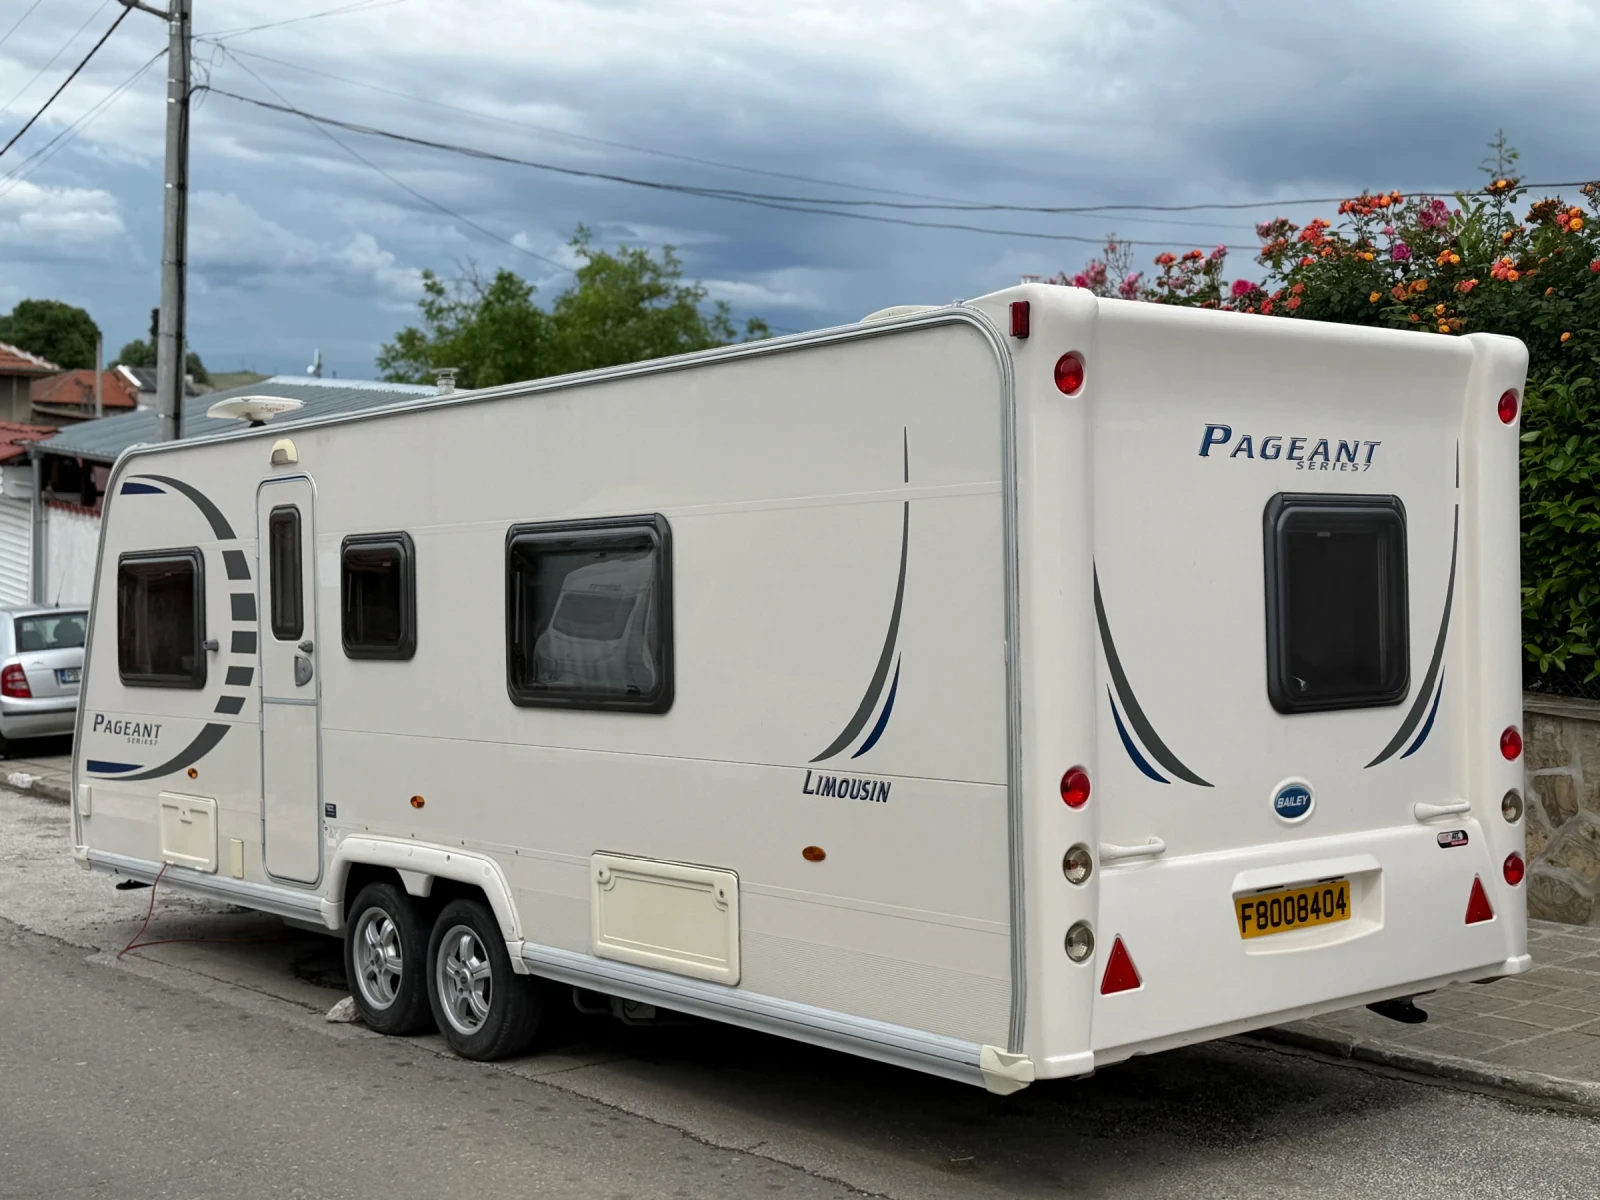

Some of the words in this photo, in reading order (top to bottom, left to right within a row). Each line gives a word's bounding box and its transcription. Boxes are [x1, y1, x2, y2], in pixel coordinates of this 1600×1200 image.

[1199, 423, 1382, 463] PAGEANT
[93, 713, 162, 739] PAGEANT
[802, 770, 891, 803] LIMOUSIN
[1276, 795, 1309, 808] BAILEY
[1241, 887, 1347, 933] F8008404
